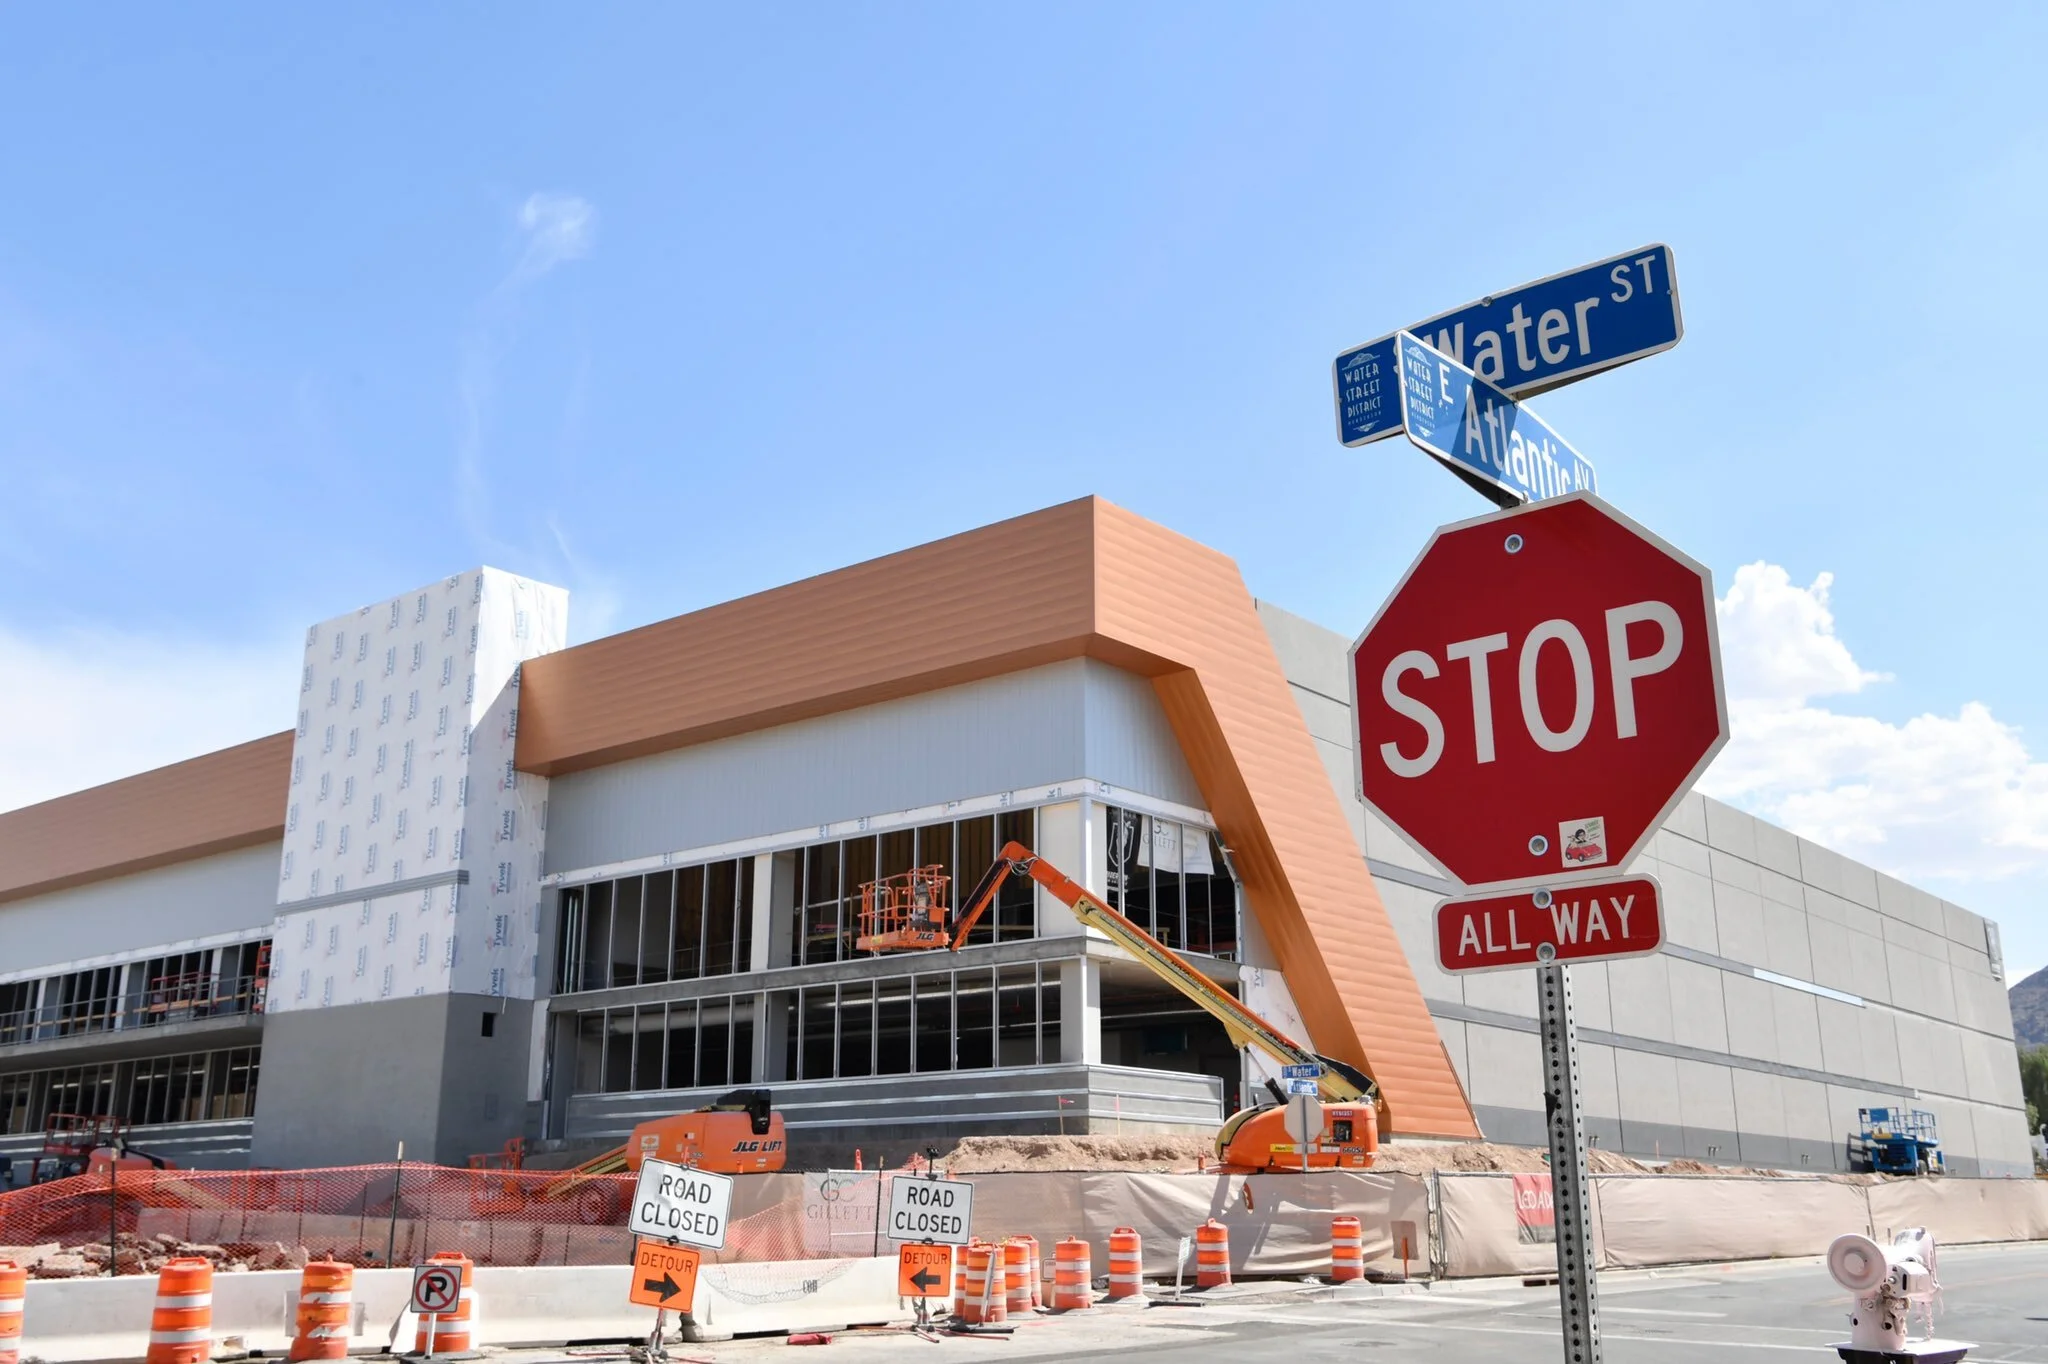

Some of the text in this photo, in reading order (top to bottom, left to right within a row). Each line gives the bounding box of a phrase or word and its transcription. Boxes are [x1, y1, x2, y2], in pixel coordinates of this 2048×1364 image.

[1610, 255, 1656, 304] ST
[1344, 362, 1380, 384] WATER
[1406, 355, 1432, 384] WATER
[1345, 379, 1380, 402] STREET
[1408, 376, 1433, 402] STREET
[1347, 396, 1382, 418] DISTRICT
[1410, 396, 1434, 420] DISTRICT
[1438, 360, 1590, 500] E Atlantic AV
[472, 575, 480, 605] Tyvek
[389, 600, 398, 628] Tyvek
[416, 595, 424, 624] Tyvek
[445, 608, 454, 637] Tyvek
[332, 632, 341, 660] Tyvek
[356, 633, 366, 661] Tyvek
[469, 624, 477, 655] Tyvek
[385, 649, 394, 677] Tyvek
[411, 643, 420, 672] Tyvek
[441, 658, 449, 687] Tyvek
[352, 681, 361, 710] Tyvek
[464, 674, 472, 706] Tyvek
[1379, 600, 1684, 778] STOP
[380, 696, 389, 725] Tyvek
[407, 692, 416, 720] Tyvek
[437, 708, 446, 736] Tyvek
[508, 709, 517, 738] Tyvek
[324, 726, 332, 754] Tyvek
[348, 729, 356, 758] Tyvek
[376, 745, 384, 774] Tyvek
[319, 773, 327, 801] Tyvek
[504, 760, 514, 790] Tyvek
[343, 777, 351, 806] Tyvek
[431, 777, 439, 807] Tyvek
[371, 795, 379, 824] Tyvek
[314, 821, 322, 850] Tyvek
[396, 810, 405, 840] Tyvek
[501, 810, 511, 841] Tyvek
[337, 827, 346, 855] Tyvek
[426, 828, 434, 859] Tyvek
[366, 844, 375, 874] Tyvek
[497, 862, 507, 895] Tyvek
[449, 884, 457, 914] Tyvek
[304, 921, 312, 950] Tyvek
[386, 913, 395, 944] Tyvek
[493, 915, 503, 947] Tyvek
[916, 932, 935, 942] JLG
[1458, 894, 1636, 957] ALL WAY
[328, 926, 337, 955] Tyvek
[417, 934, 426, 965] Tyvek
[356, 947, 365, 977] Tyvek
[321, 977, 330, 1006] Tyvek
[382, 965, 390, 996] Tyvek
[491, 968, 500, 995] yvek
[1291, 1066, 1312, 1077] Water
[732, 1141, 782, 1152] JLG LIFT
[658, 1173, 712, 1204] ROAD
[906, 1186, 954, 1208] ROAD
[641, 1201, 719, 1236] CLOSED
[806, 1204, 876, 1221] GILLETT
[895, 1211, 962, 1235] CLOSED
[641, 1251, 694, 1275] DETOUR
[904, 1251, 948, 1265] DETOUR
